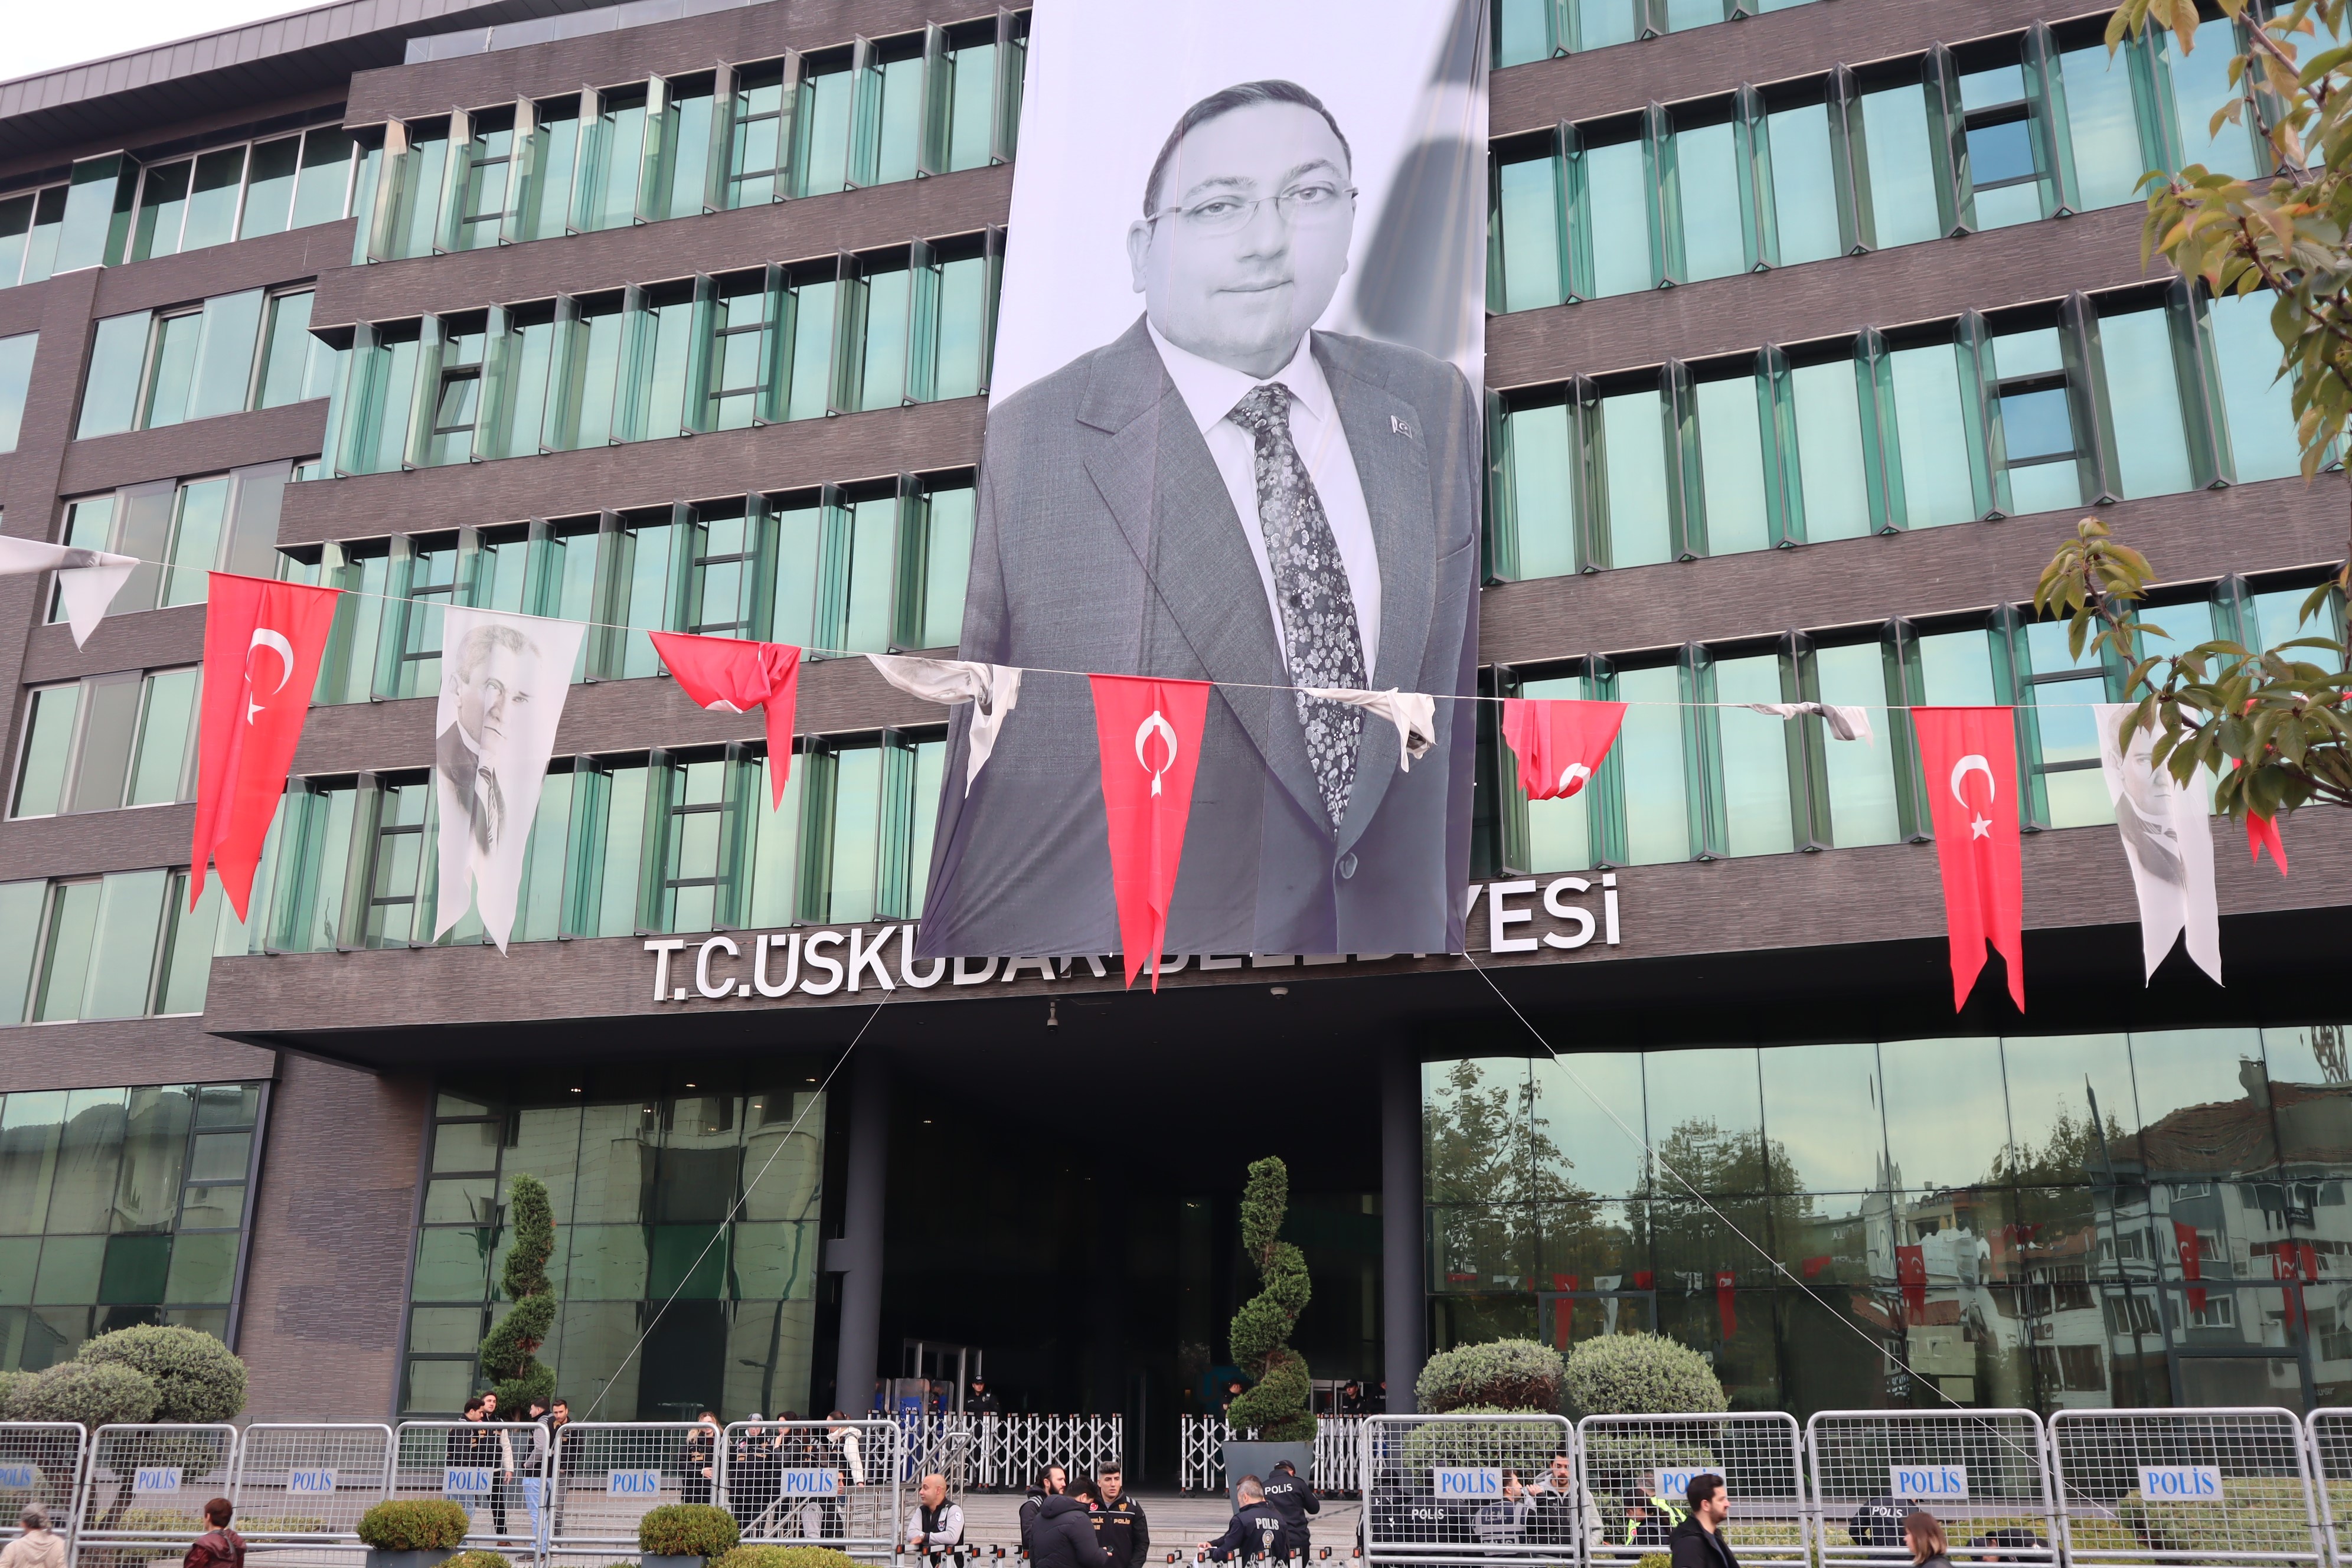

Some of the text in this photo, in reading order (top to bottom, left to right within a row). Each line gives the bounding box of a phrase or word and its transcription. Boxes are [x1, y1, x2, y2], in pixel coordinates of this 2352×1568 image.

[138, 1467, 176, 1489] POLİS
[292, 1468, 332, 1491] POLİS
[448, 1468, 489, 1490] POLİS
[613, 1471, 656, 1492] POLİS
[787, 1468, 834, 1492] POLİS
[1442, 1468, 1497, 1494] POLİS
[1899, 1466, 1961, 1494] POLİS
[2147, 1467, 2214, 1495] POLİS
